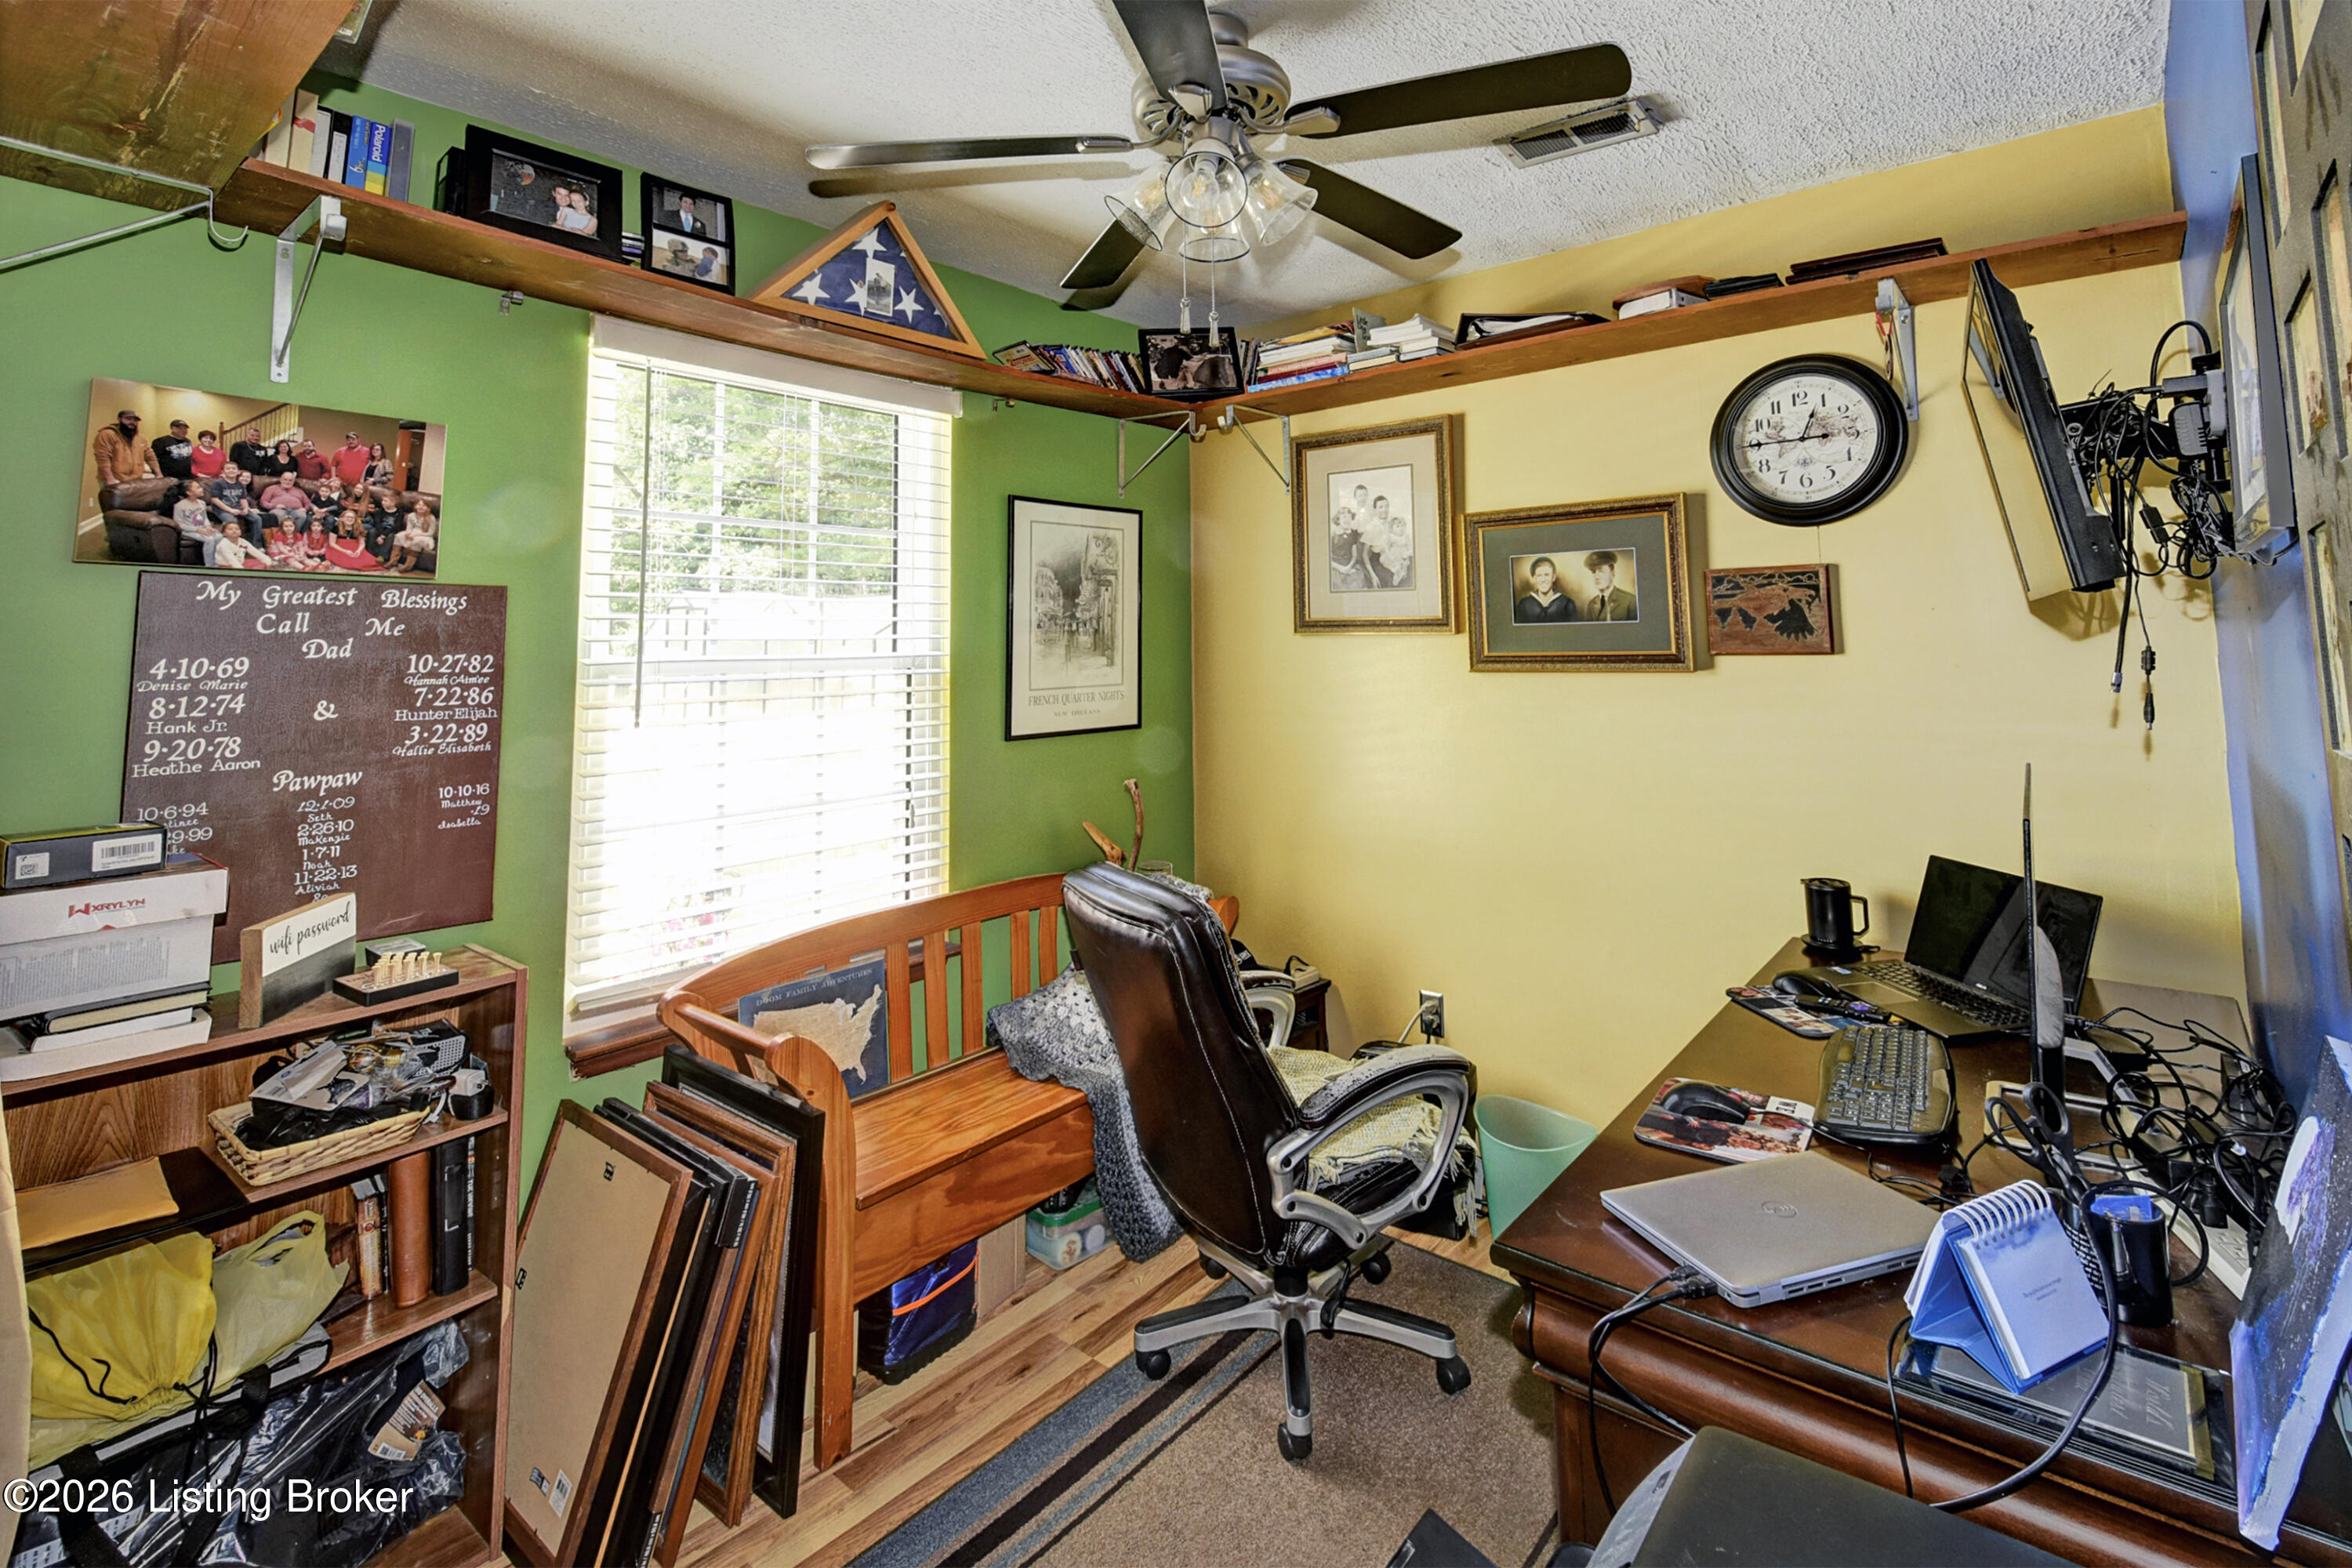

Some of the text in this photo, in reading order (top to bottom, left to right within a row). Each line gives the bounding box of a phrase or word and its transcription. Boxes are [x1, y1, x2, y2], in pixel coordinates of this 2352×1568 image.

[372, 124, 387, 163] Polaroid
[1791, 390, 1808, 407] 12
[1821, 393, 1826, 407] 1
[1770, 400, 1780, 415] 11
[1838, 404, 1849, 419] 2
[1755, 418, 1770, 432] 10
[1759, 459, 1771, 474] 8
[1823, 465, 1836, 481] 5
[1778, 470, 1788, 485] 7
[1799, 473, 1813, 488] 6
[196, 580, 468, 615] My Greatest Blessings
[256, 612, 406, 637] Call Me
[301, 637, 354, 659] Dad
[136, 680, 249, 691] Denise Marie
[404, 673, 448, 686] Hannah
[1029, 690, 1125, 706] FRENCH QUARTER NIGHTS
[314, 700, 339, 720] &
[394, 706, 498, 722] Hunter Elijah
[145, 720, 228, 735] Hank Jr.
[392, 742, 492, 757] Hallie Elisabeth
[131, 759, 261, 778] Heathe Aaron
[272, 770, 363, 797] Pawpaw
[441, 799, 482, 809] Matthew
[307, 812, 333, 823] Seth
[437, 817, 482, 829] Isabella
[303, 860, 332, 870] Noah
[295, 883, 341, 895] Aliviah
[270, 901, 350, 955] wifi password
[756, 967, 873, 1007] DOOM FAMILY ADVENTURES
